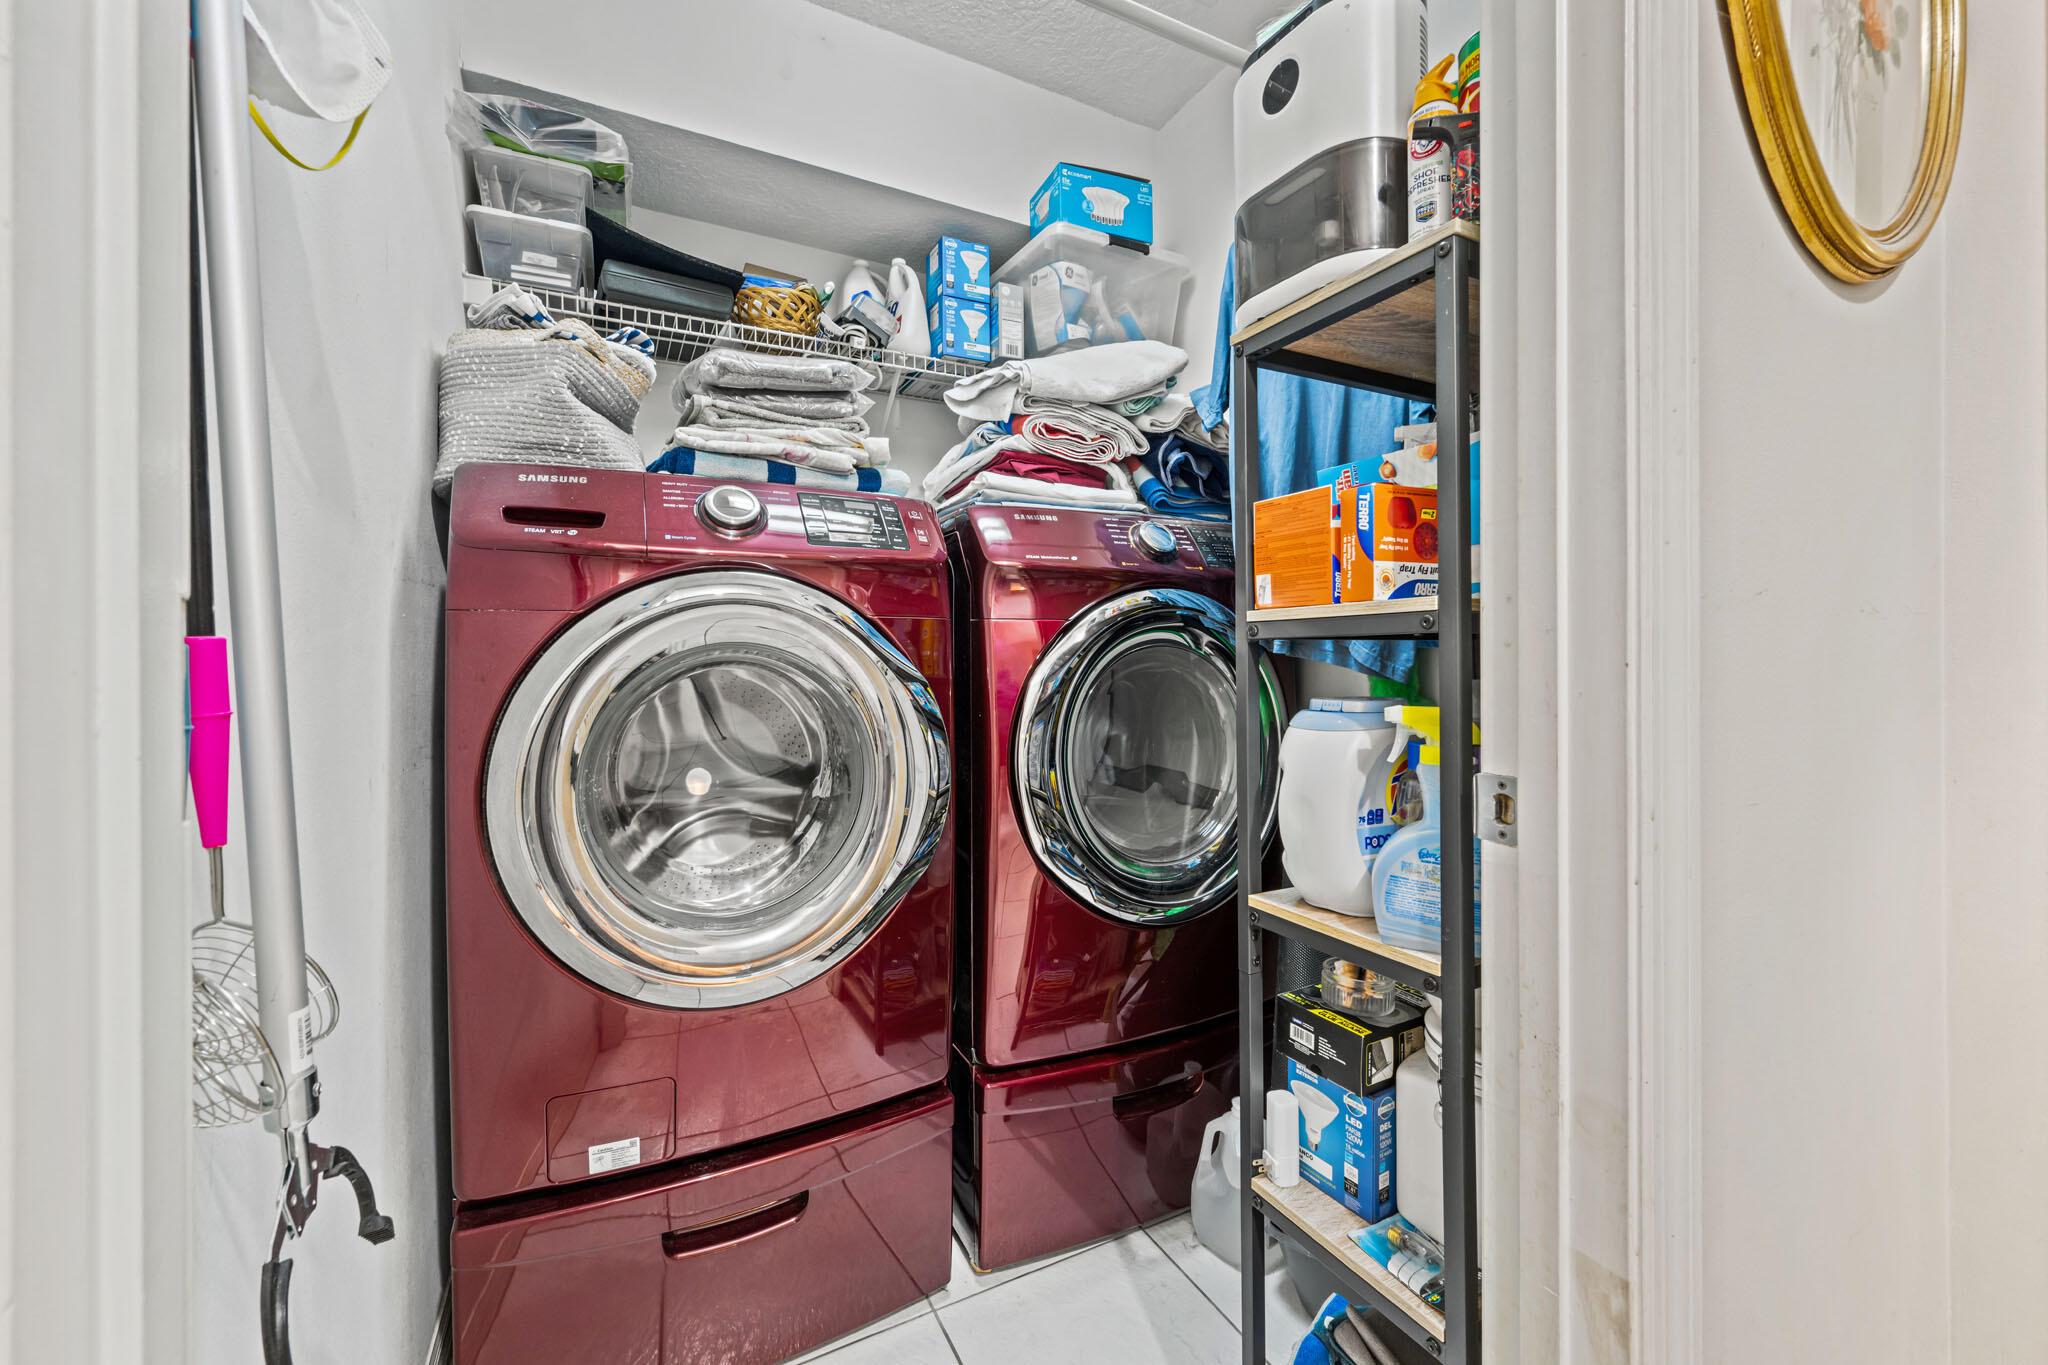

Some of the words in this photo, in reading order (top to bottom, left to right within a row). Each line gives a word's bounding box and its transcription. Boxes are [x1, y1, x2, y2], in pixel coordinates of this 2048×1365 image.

[518, 474, 588, 484] SAMSUNG
[1014, 513, 1058, 521] SAMSUNG
[1358, 492, 1371, 531] TERRO
[1400, 564, 1415, 574] Trap
[1418, 565, 1429, 575] Fly
[1414, 583, 1438, 596] ERRO
[1346, 1114, 1363, 1129] LED
[1380, 1121, 1392, 1133] DEL
